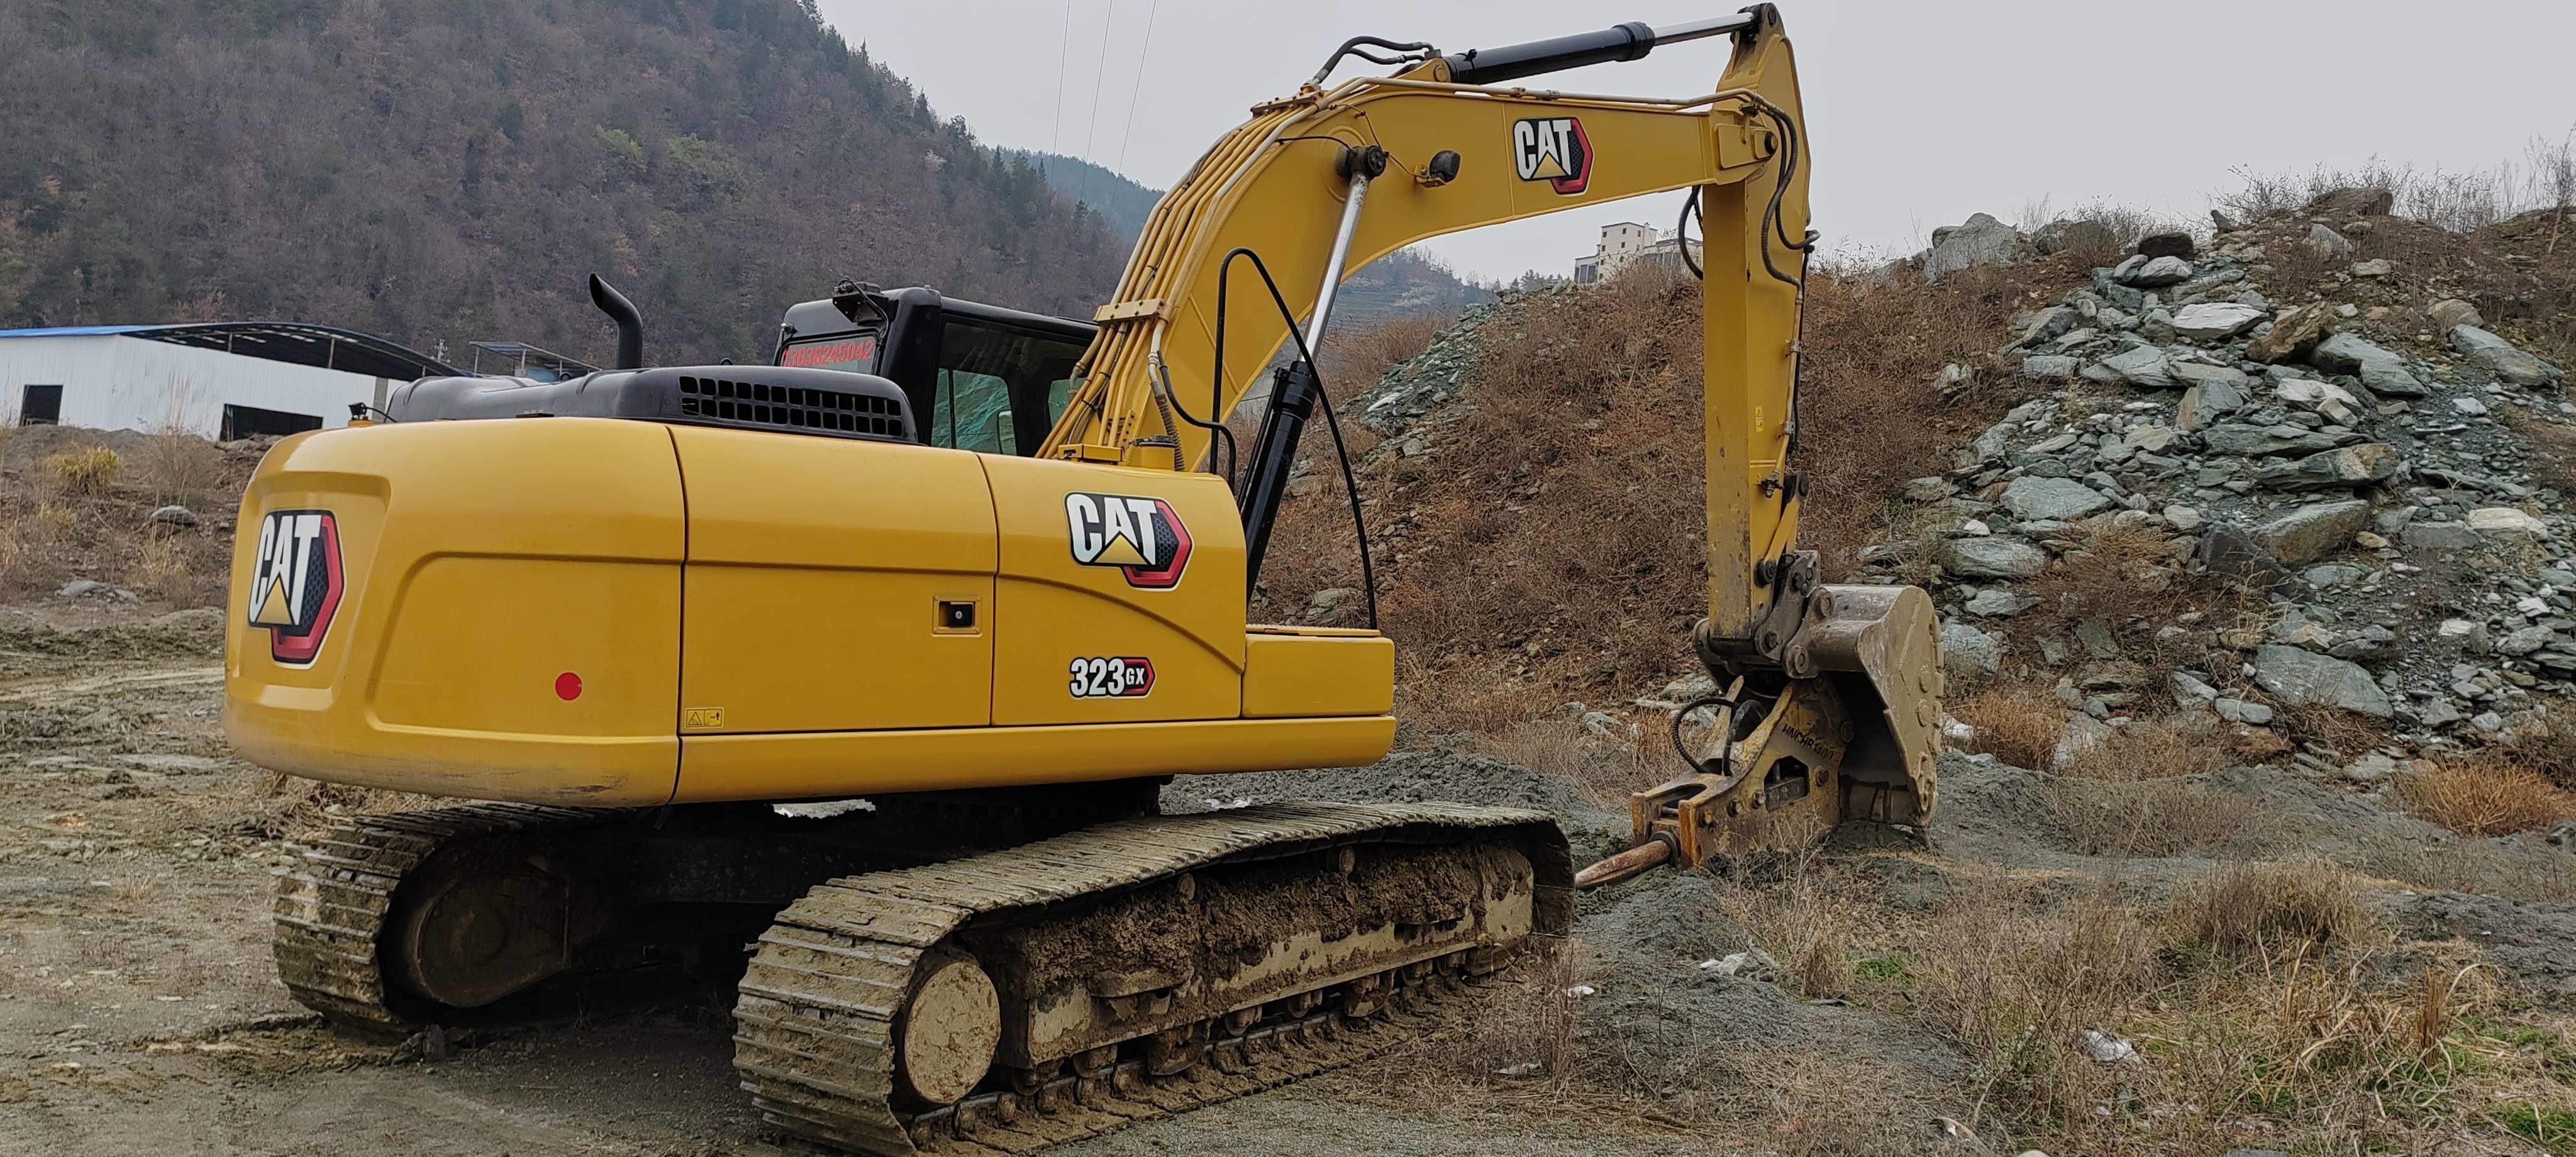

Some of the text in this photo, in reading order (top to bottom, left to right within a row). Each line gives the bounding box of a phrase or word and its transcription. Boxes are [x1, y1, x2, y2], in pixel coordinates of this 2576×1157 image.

[1514, 119, 1572, 180] CAT
[1067, 494, 1158, 565] CAT
[249, 514, 321, 626] CAT
